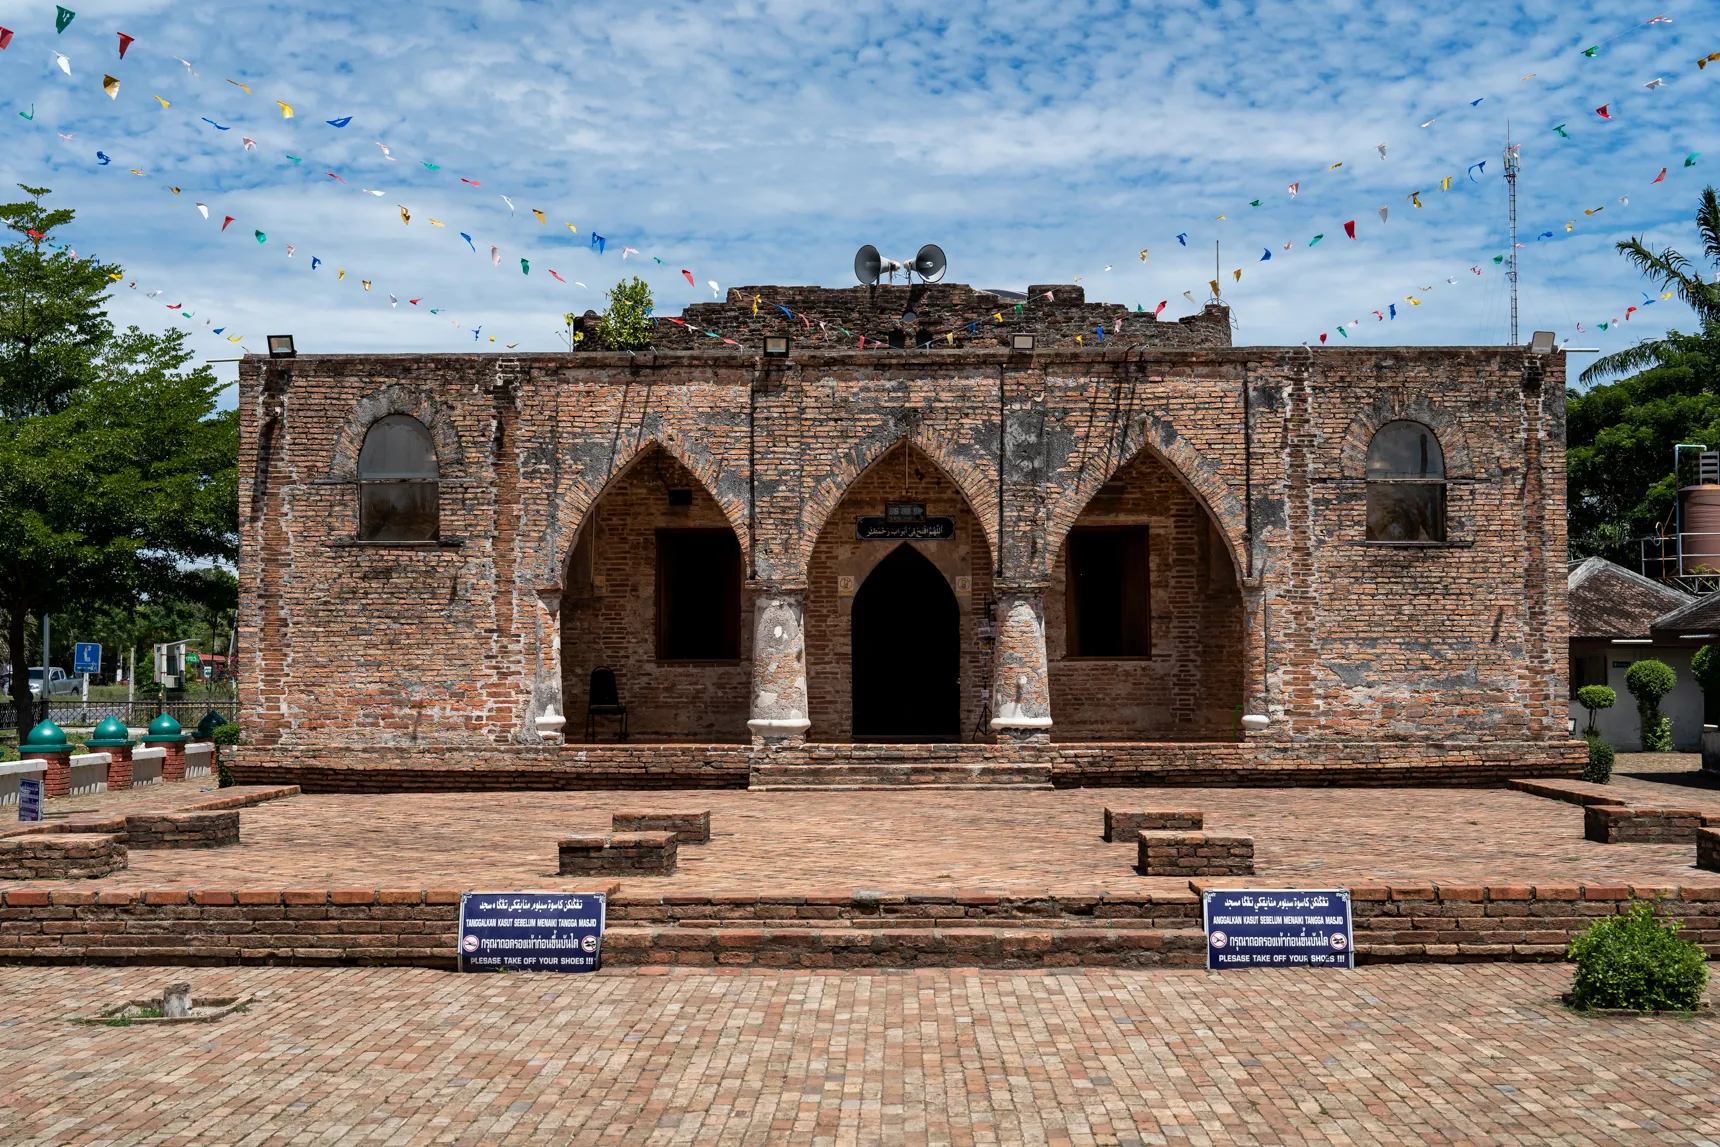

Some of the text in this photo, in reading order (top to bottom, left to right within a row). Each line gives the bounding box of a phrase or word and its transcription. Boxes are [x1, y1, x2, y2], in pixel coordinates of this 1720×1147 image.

[466, 919, 596, 927] TANGGALKAN KASUT SEBELUM MENAIKI TANGGA MASJID
[1213, 916, 1343, 924] ANGGALKAN KASUT SEBELUM MENAIKI TANGGA MASJID
[471, 957, 501, 965] PLESASE
[505, 957, 522, 965] TAKE
[523, 957, 536, 965] OFF
[539, 957, 558, 965] YOUR
[561, 957, 584, 965] SHOES
